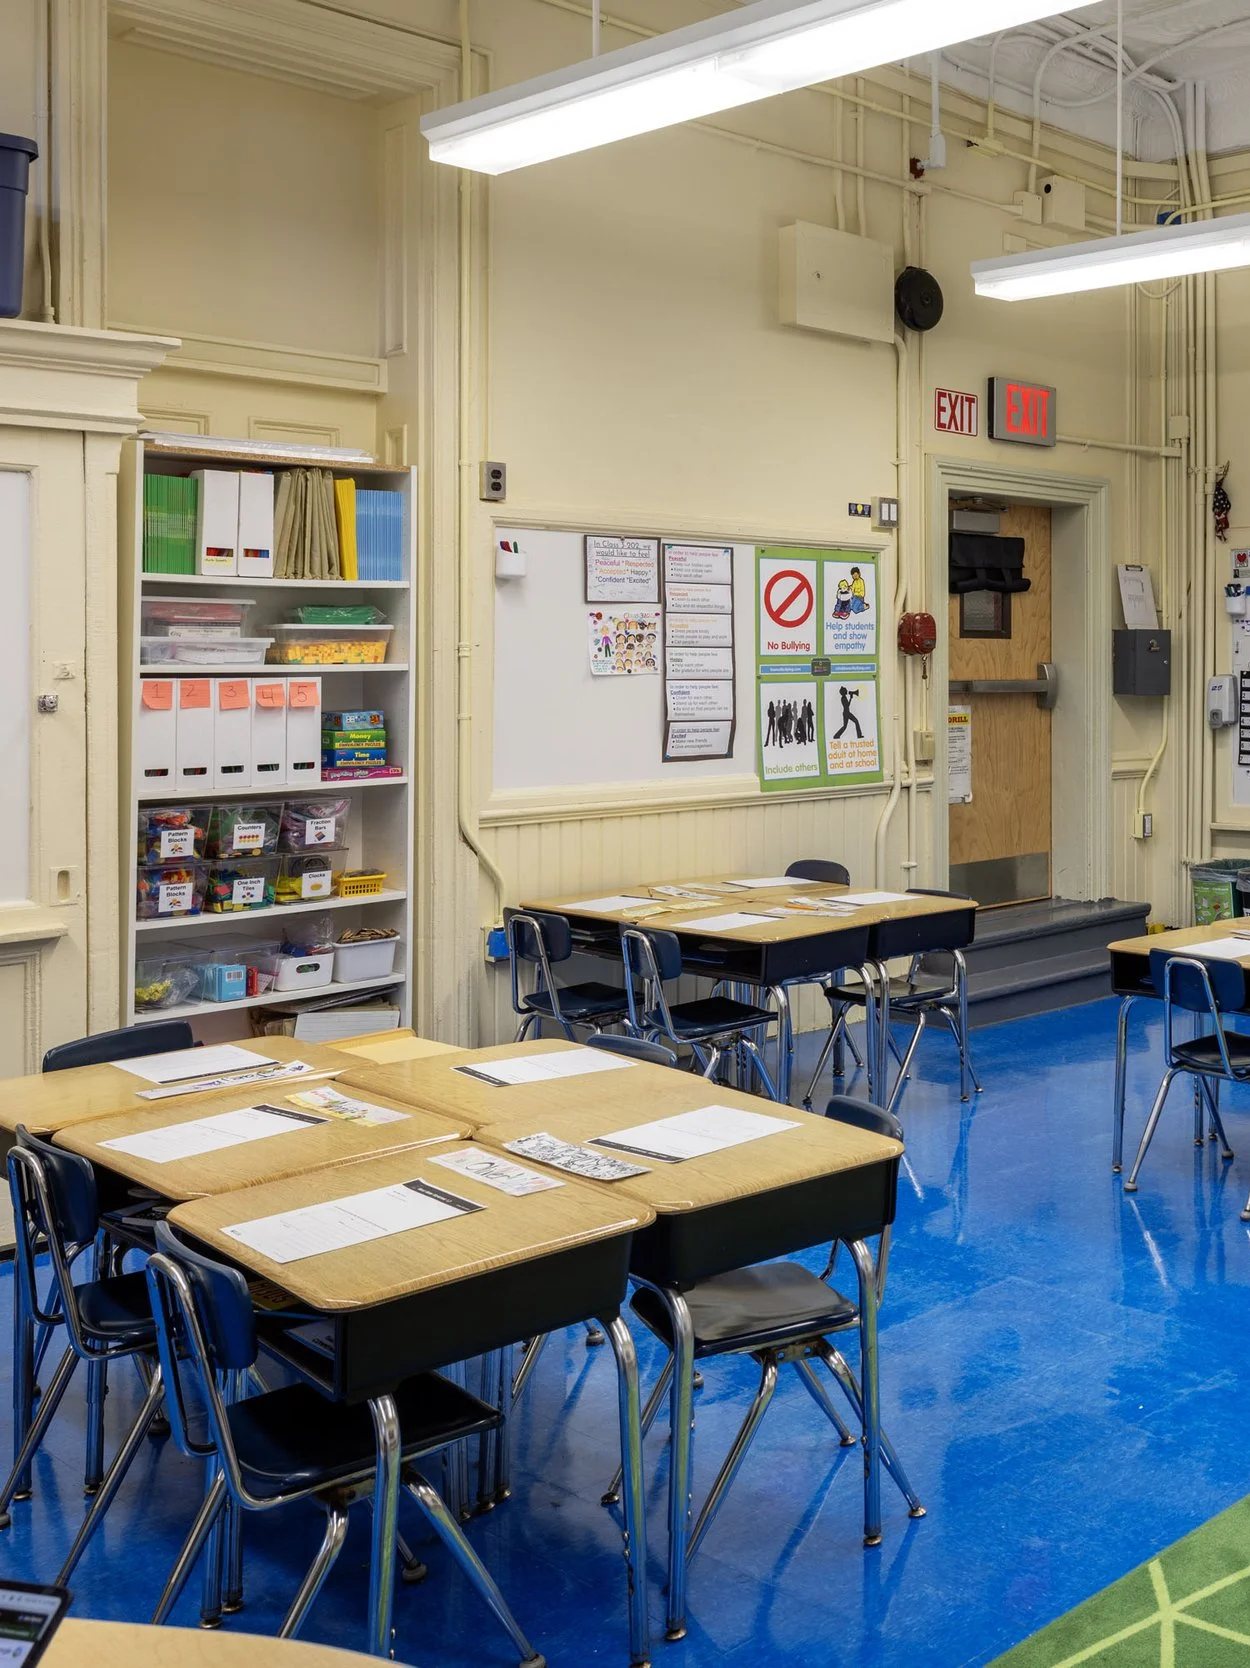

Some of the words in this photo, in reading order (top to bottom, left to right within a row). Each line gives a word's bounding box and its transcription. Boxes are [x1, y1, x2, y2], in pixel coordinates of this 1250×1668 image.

[937, 391, 975, 433] EXIT
[1006, 384, 1050, 438] EXIT
[826, 622, 844, 632] Help
[845, 622, 874, 630] students
[832, 632, 847, 640] and
[848, 632, 868, 640] show
[768, 642, 778, 650] No
[782, 641, 810, 652] Bullying
[834, 641, 866, 652] empathy
[152, 684, 164, 698] 1
[186, 684, 197, 697] 2
[225, 686, 237, 698] 3
[262, 688, 274, 704] 4
[298, 686, 308, 702] 5
[830, 741, 842, 749] Tell
[850, 740, 874, 748] trusted
[828, 751, 846, 760] adult
[858, 749, 877, 758] home
[766, 765, 792, 774] Include
[794, 763, 818, 772] others
[830, 761, 844, 770] and
[855, 758, 876, 768] school
